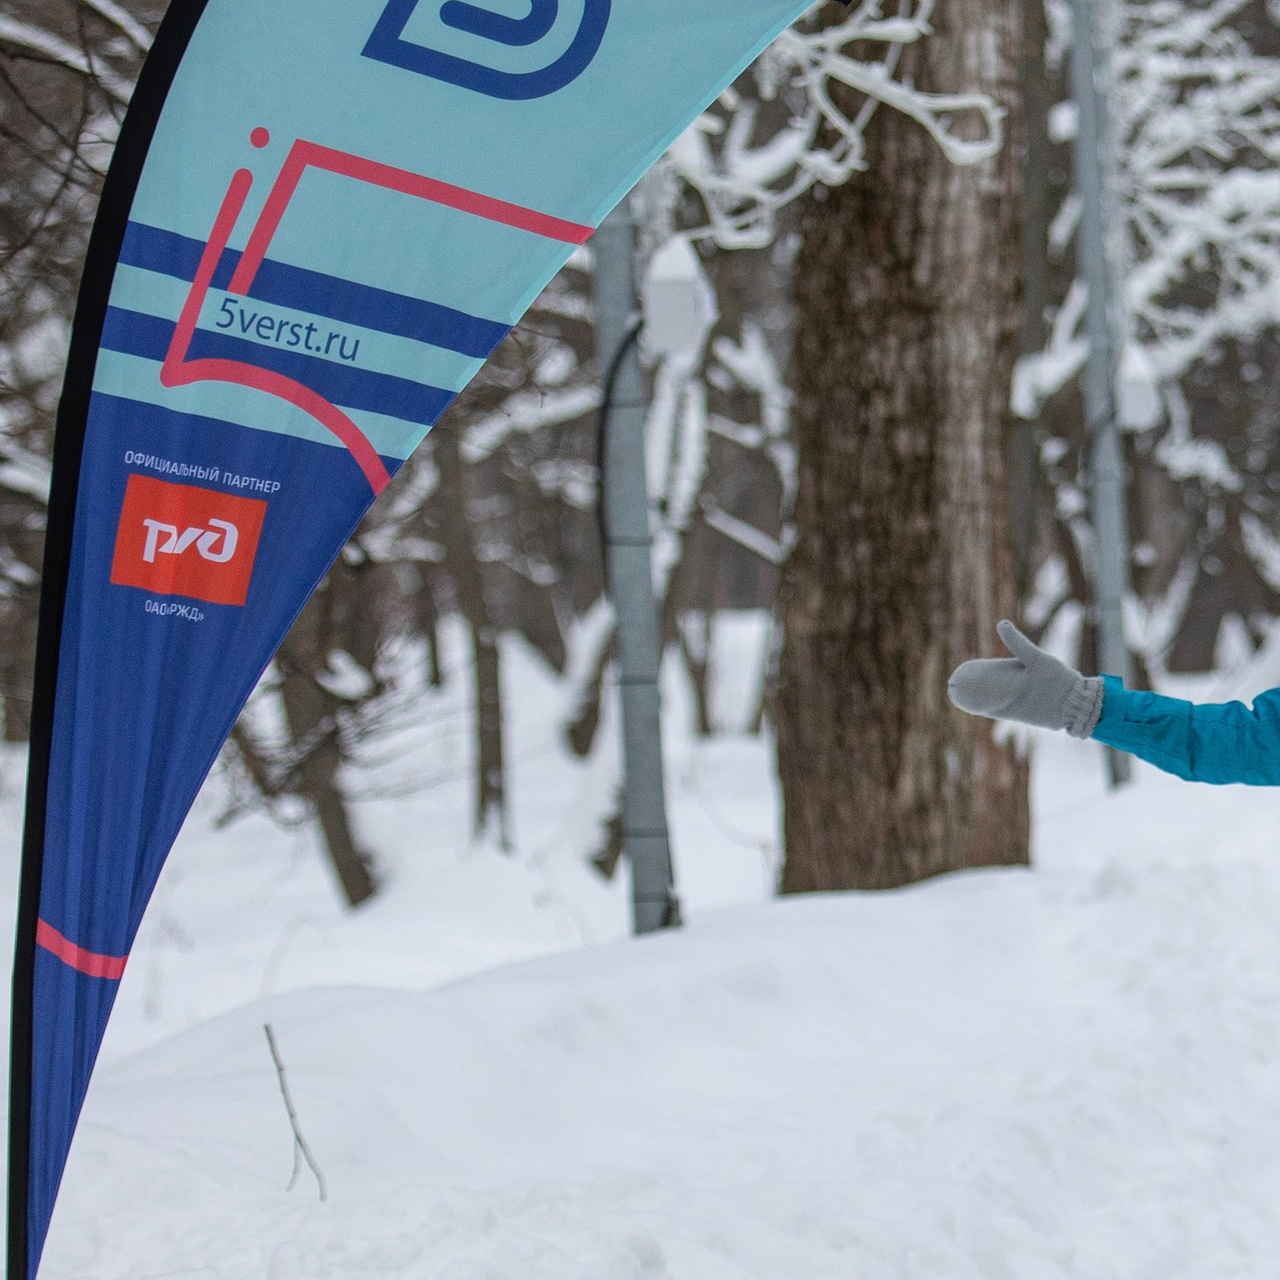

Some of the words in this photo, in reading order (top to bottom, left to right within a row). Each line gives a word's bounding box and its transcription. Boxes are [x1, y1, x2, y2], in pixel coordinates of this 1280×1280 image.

[215, 297, 360, 361] 5verst.ru
[124, 451, 219, 482] ОФИЦИАЛЬНЫЙ
[222, 472, 281, 494] ПАРТНЕР
